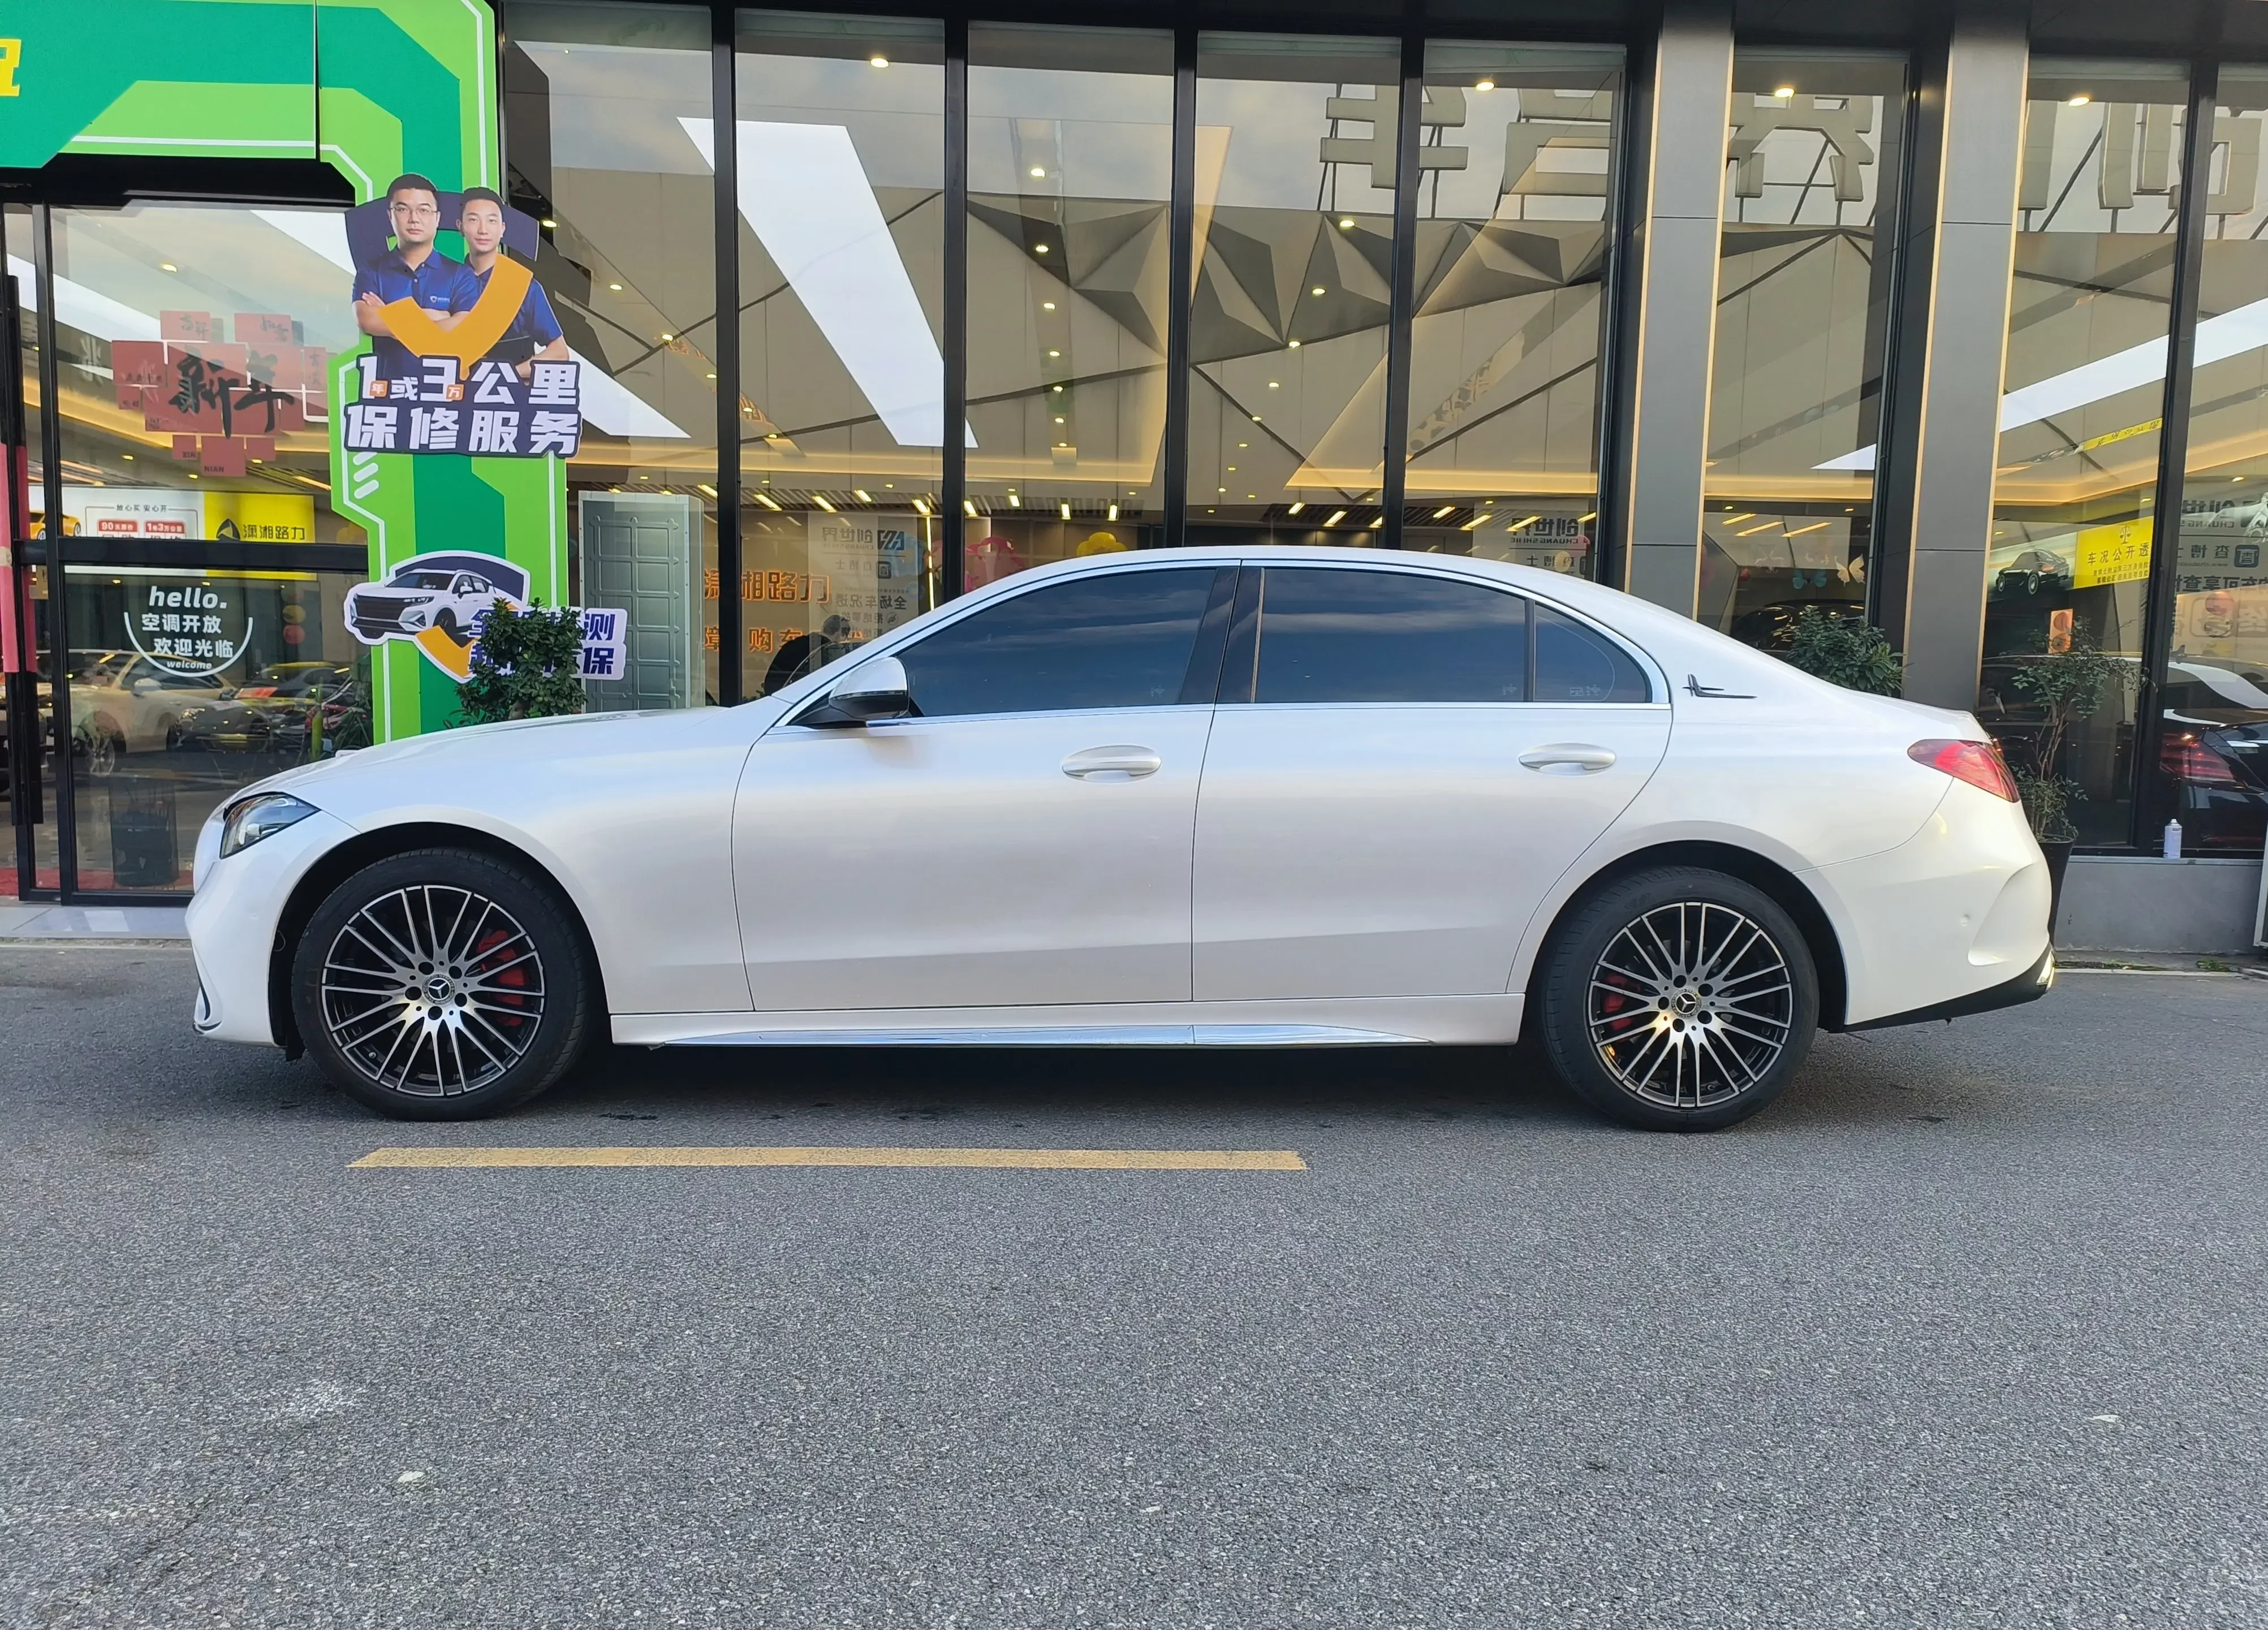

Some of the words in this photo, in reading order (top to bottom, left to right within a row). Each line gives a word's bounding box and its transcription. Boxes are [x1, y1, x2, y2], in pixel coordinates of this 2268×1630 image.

[347, 404, 579, 454] 保修服务
[2087, 541, 2149, 566] 车况公开透
[149, 585, 227, 609] hello.
[141, 613, 222, 634] 空调开放
[153, 637, 234, 658] 欢迎光临
[166, 660, 213, 670] welcome
